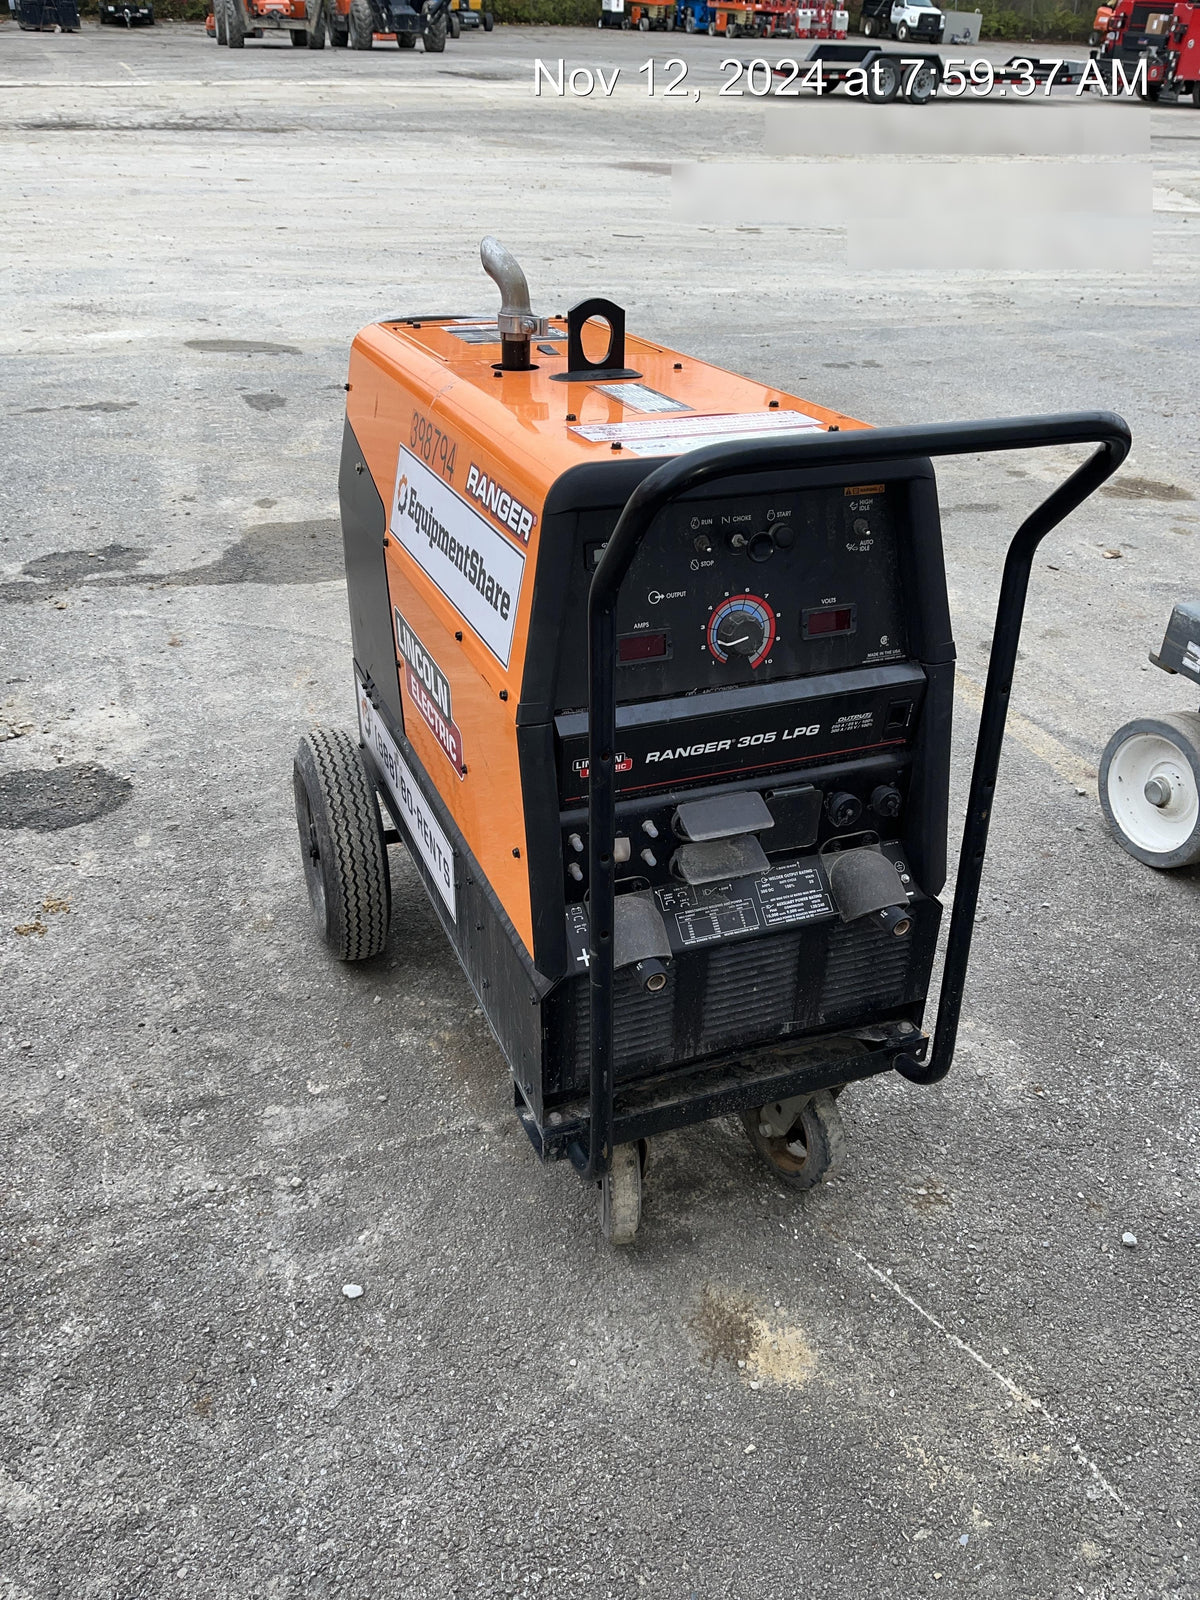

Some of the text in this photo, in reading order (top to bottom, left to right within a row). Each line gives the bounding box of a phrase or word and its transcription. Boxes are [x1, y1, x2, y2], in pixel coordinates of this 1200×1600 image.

[410, 411, 458, 482] 398794
[732, 514, 752, 522] CHOKE
[777, 510, 792, 518] START
[407, 486, 511, 621] EquipmentShare
[666, 590, 686, 599] OUTPUT
[634, 622, 650, 630] AMPS
[397, 617, 448, 718] LINCOLN
[410, 674, 457, 762] ELECTRIC
[737, 732, 777, 748] 305
[782, 724, 820, 740] LPG
[575, 754, 622, 770] LINN
